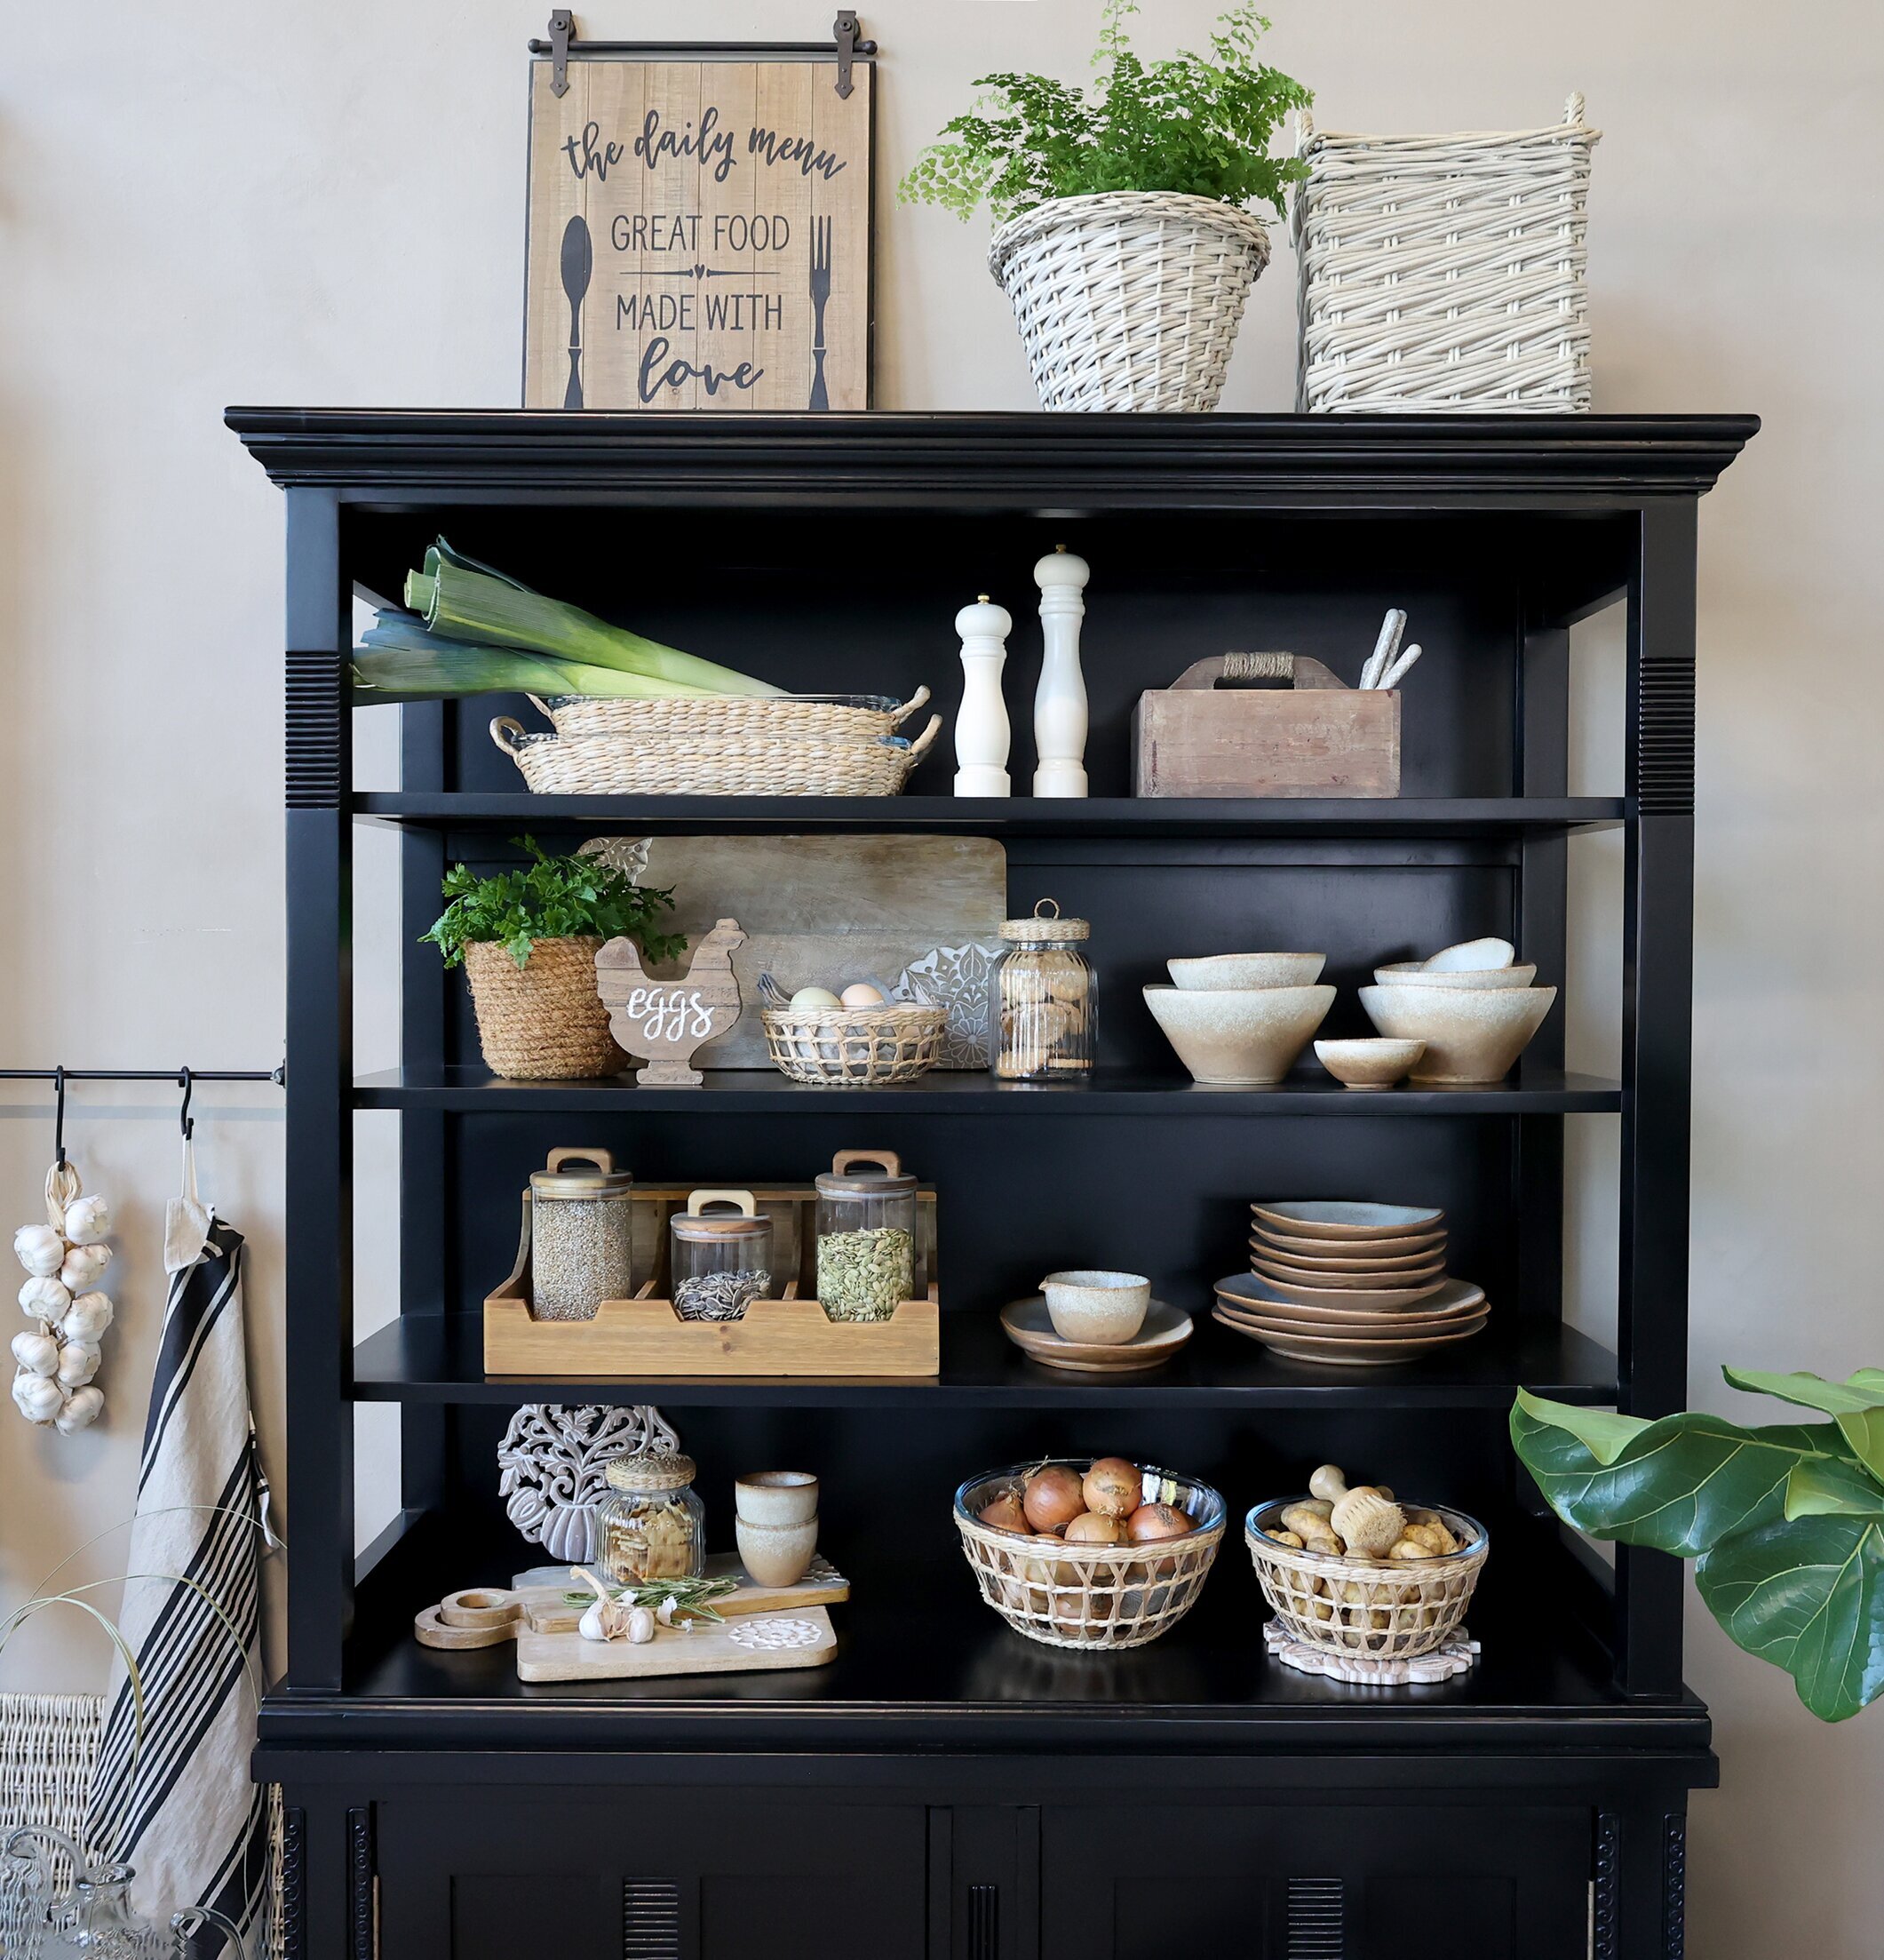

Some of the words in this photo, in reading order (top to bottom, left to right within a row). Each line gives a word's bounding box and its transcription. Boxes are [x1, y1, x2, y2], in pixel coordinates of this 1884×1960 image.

[560, 122, 624, 182] the
[634, 107, 737, 183] daily
[748, 127, 847, 180] menu
[611, 215, 703, 251] GREAT
[714, 215, 790, 251] FOOD
[616, 294, 696, 331] MADE
[706, 294, 783, 331] WITH
[640, 337, 764, 403] love
[626, 987, 715, 1042] eggs
